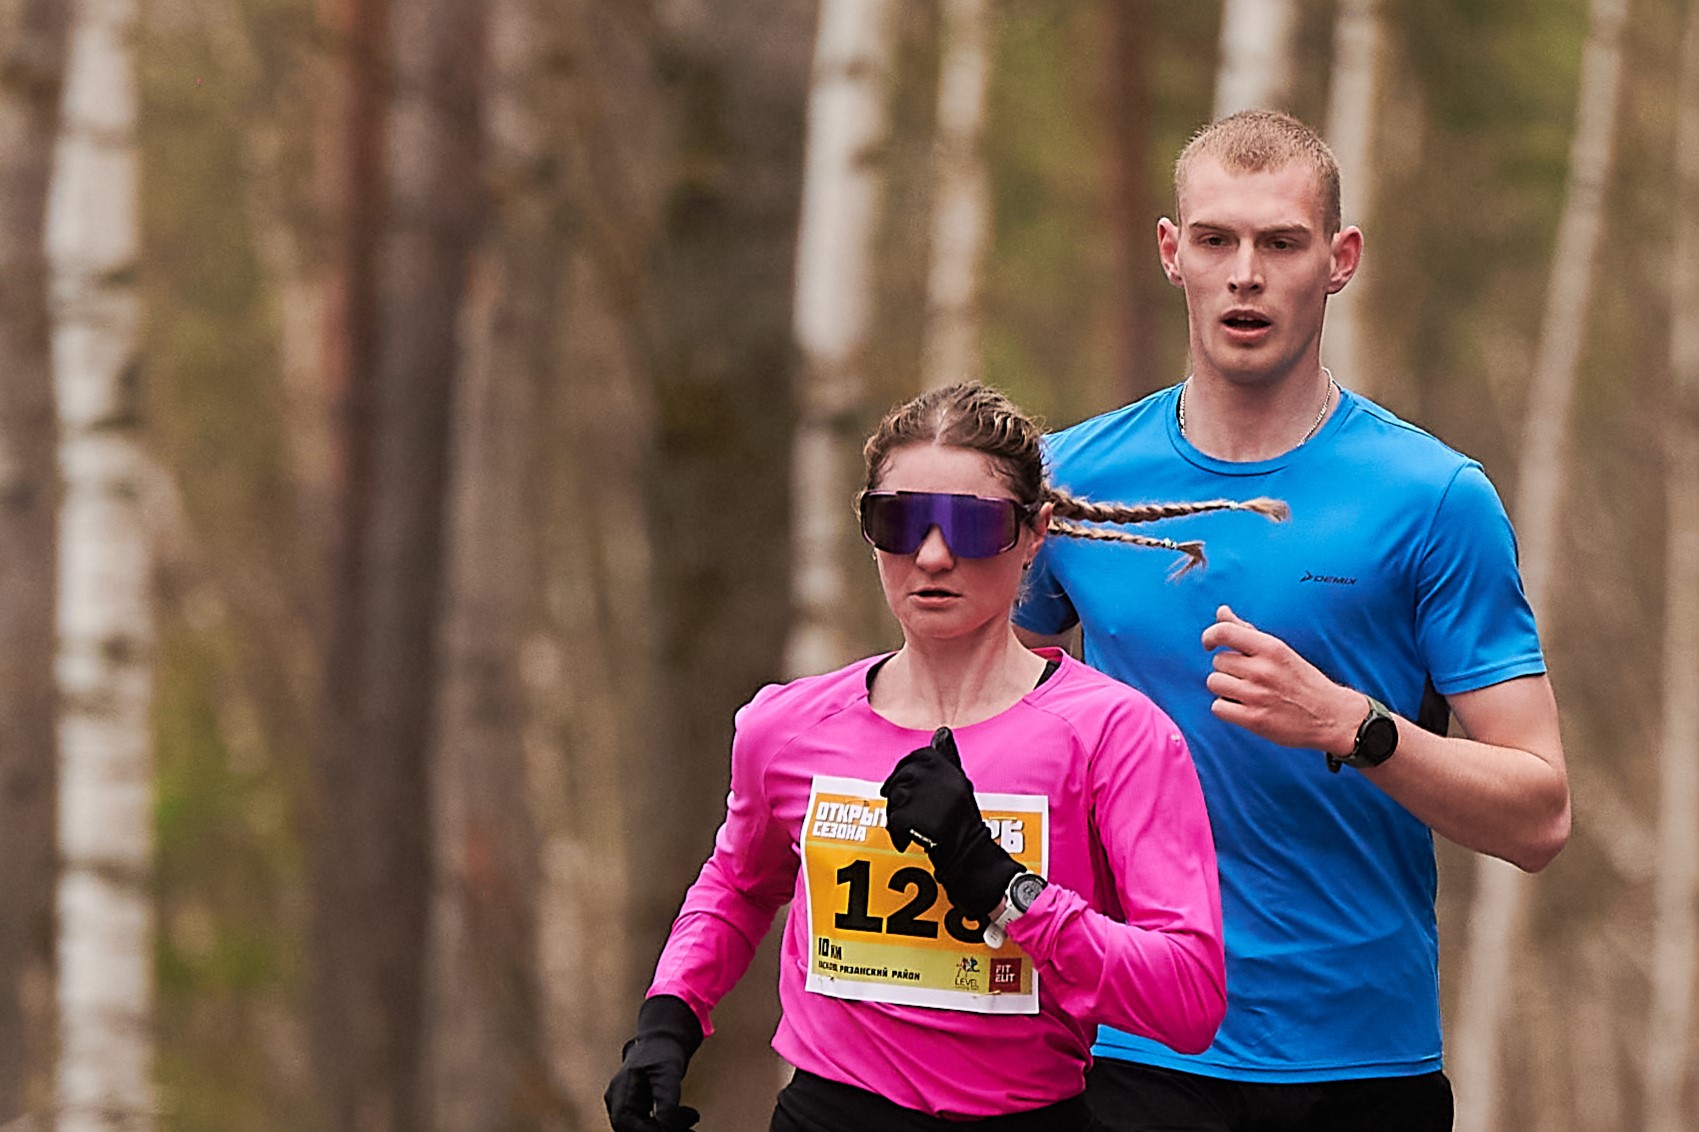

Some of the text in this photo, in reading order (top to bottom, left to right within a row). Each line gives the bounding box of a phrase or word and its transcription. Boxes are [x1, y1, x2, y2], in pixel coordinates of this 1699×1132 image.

[1313, 575, 1357, 585] DEMIX
[812, 820, 867, 843] СЕЗОНА
[839, 965, 888, 977] РЯЗАНСКИЙ
[891, 968, 920, 980] РАЙОН
[995, 964, 1012, 974] FIT
